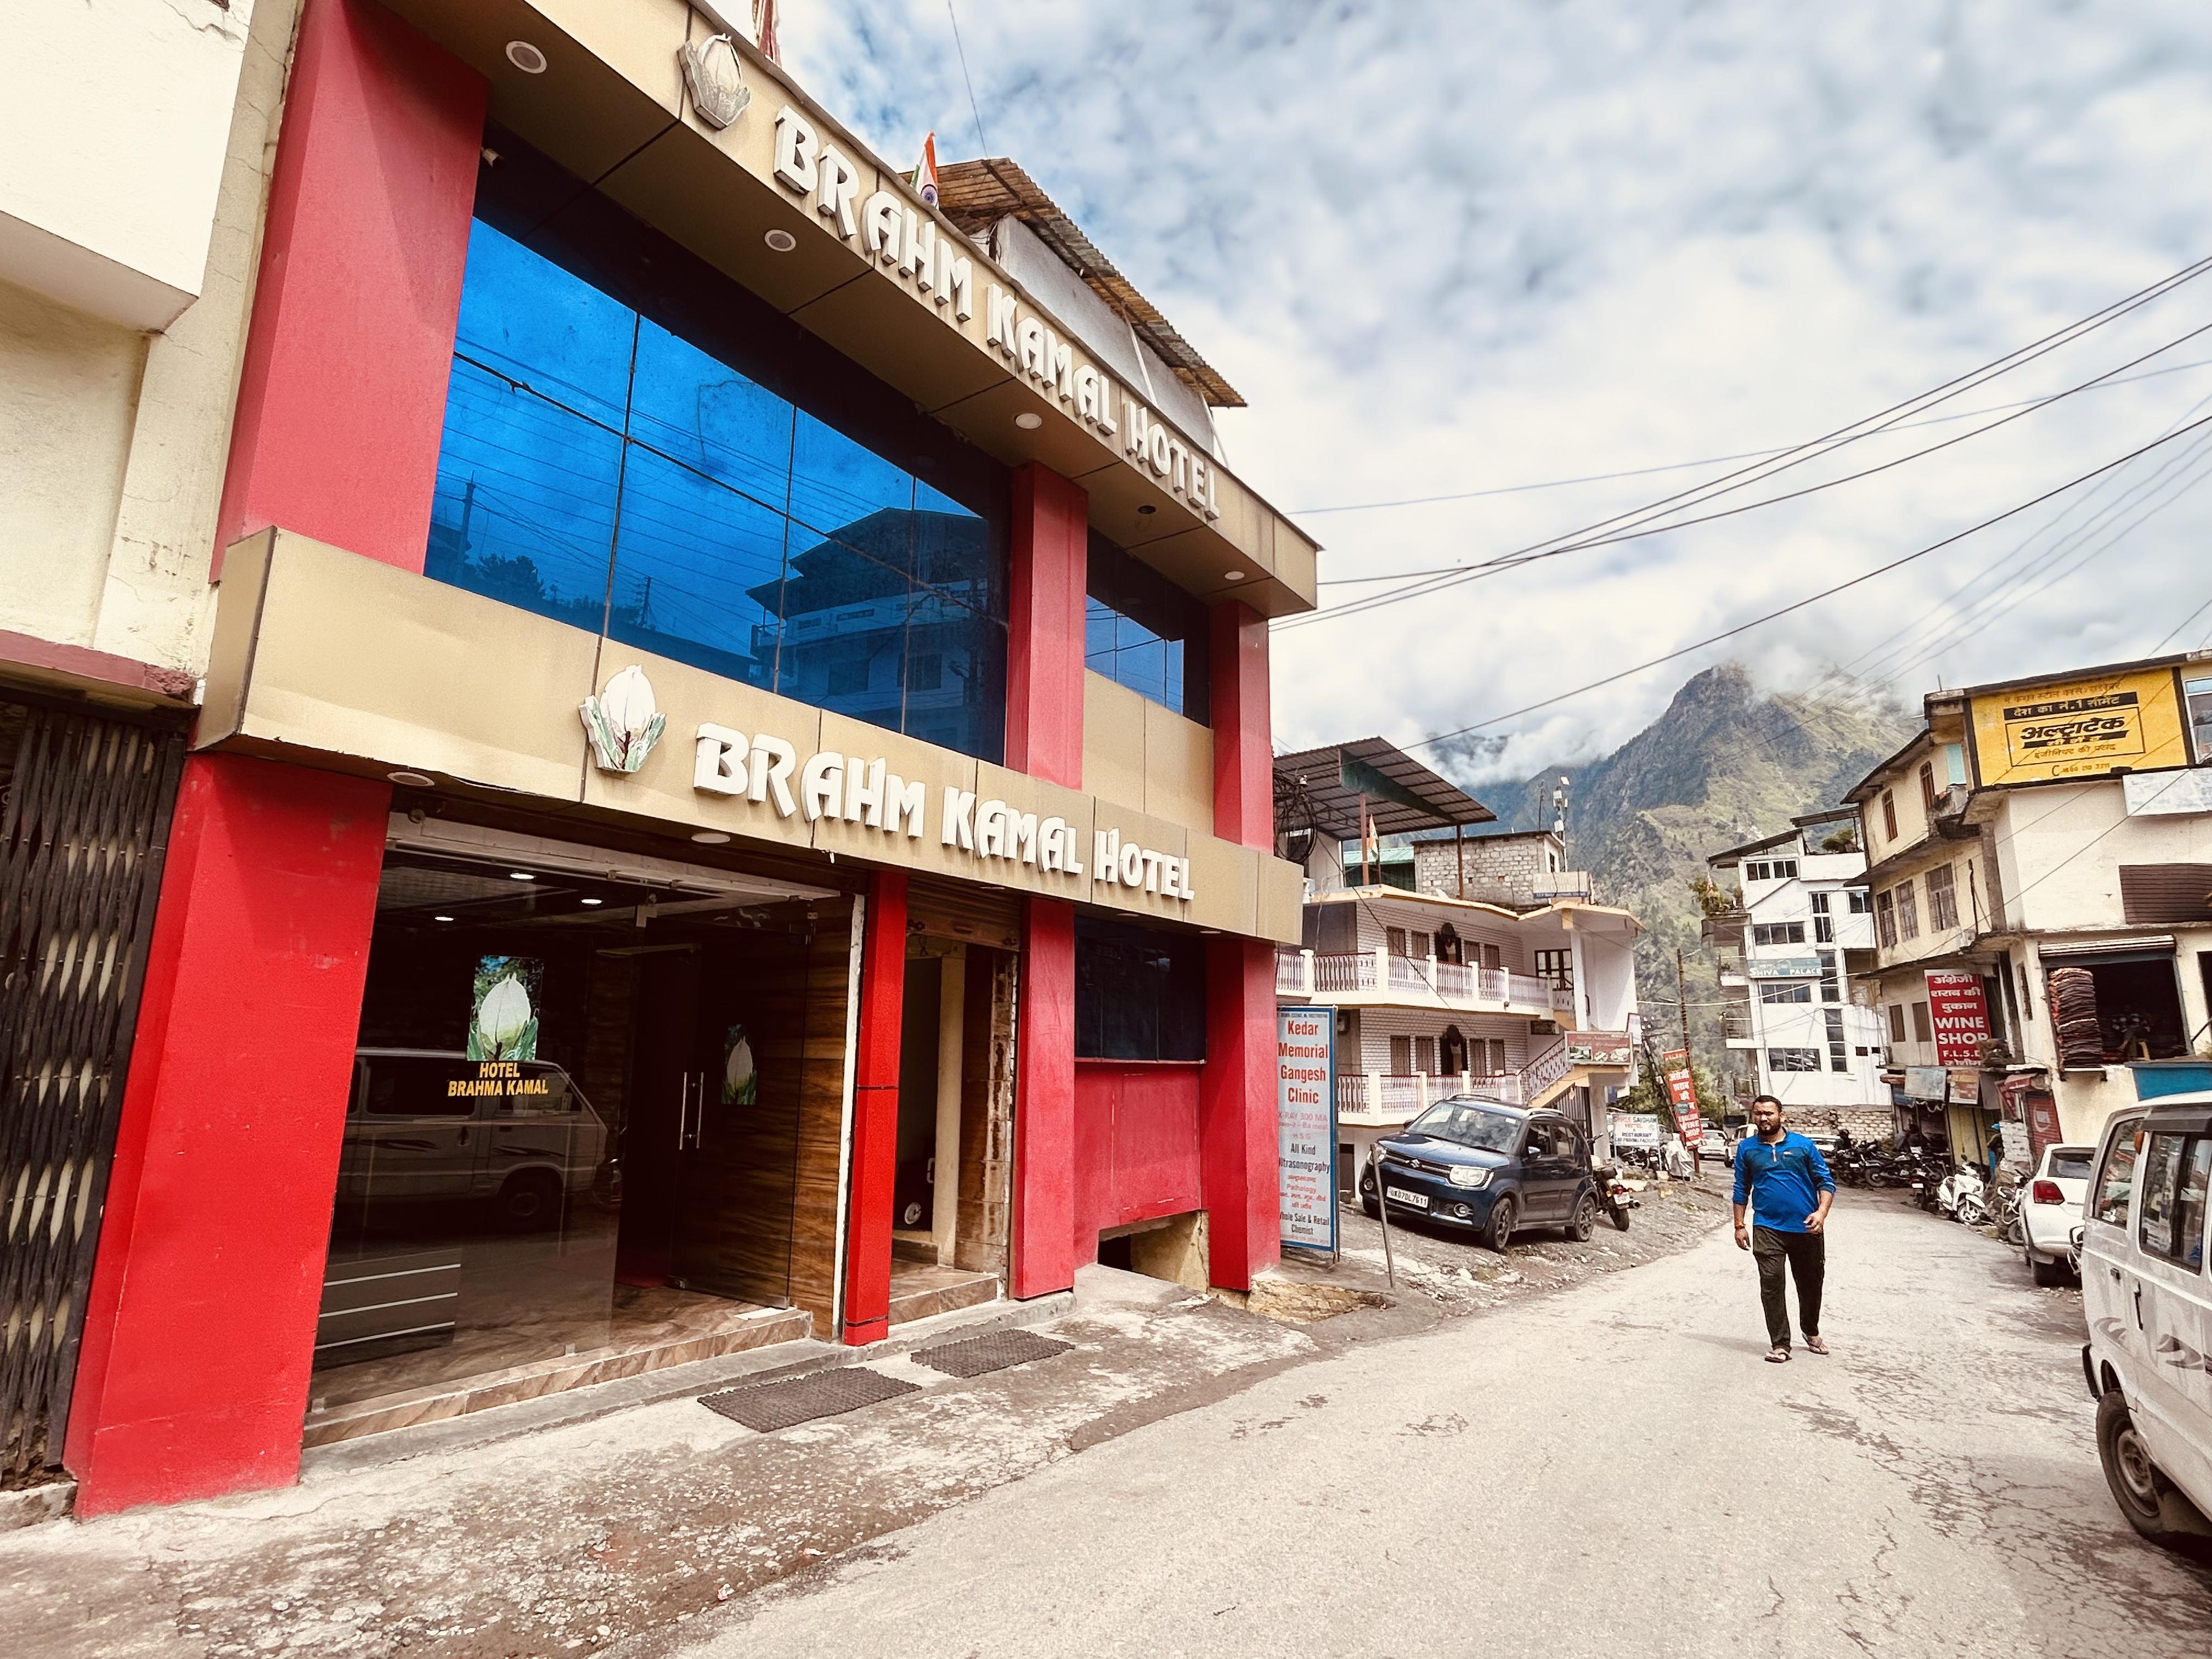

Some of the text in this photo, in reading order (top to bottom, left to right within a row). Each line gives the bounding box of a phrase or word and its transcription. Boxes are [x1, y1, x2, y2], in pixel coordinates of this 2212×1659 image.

[774, 105, 1221, 520] BRAHM KAMAL HOTEL
[2037, 705, 2053, 713] का
[2021, 716, 2125, 739] अल्ट्राटेक
[2078, 744, 2091, 753] की
[693, 722, 1195, 900] BRAHM KAMAL HOTEL
[1749, 967, 1779, 975] SHIVA
[1933, 974, 1973, 985] अंग्रेजी
[1963, 986, 1981, 996] की
[1941, 1002, 1977, 1014] दुकान
[1288, 1020, 1319, 1036] Kedar
[1934, 1017, 1985, 1029] WINE
[1938, 1032, 1989, 1045] SHOP
[1278, 1042, 1328, 1059] Memorial
[479, 1063, 520, 1078] HOTEL
[1281, 1064, 1326, 1084] Gangesh
[448, 1079, 549, 1097] BRAHMA KAMAL
[1288, 1087, 1319, 1104] Clinic
[1278, 1111, 1298, 1119] X-RAY
[1290, 1143, 1316, 1155] All Kind
[1286, 1183, 1316, 1194] Pathology
[1295, 1213, 1306, 1223] Sale
[1308, 1215, 1312, 1223] &
[1313, 1215, 1330, 1226] Retail
[1291, 1224, 1313, 1235] Chemist
